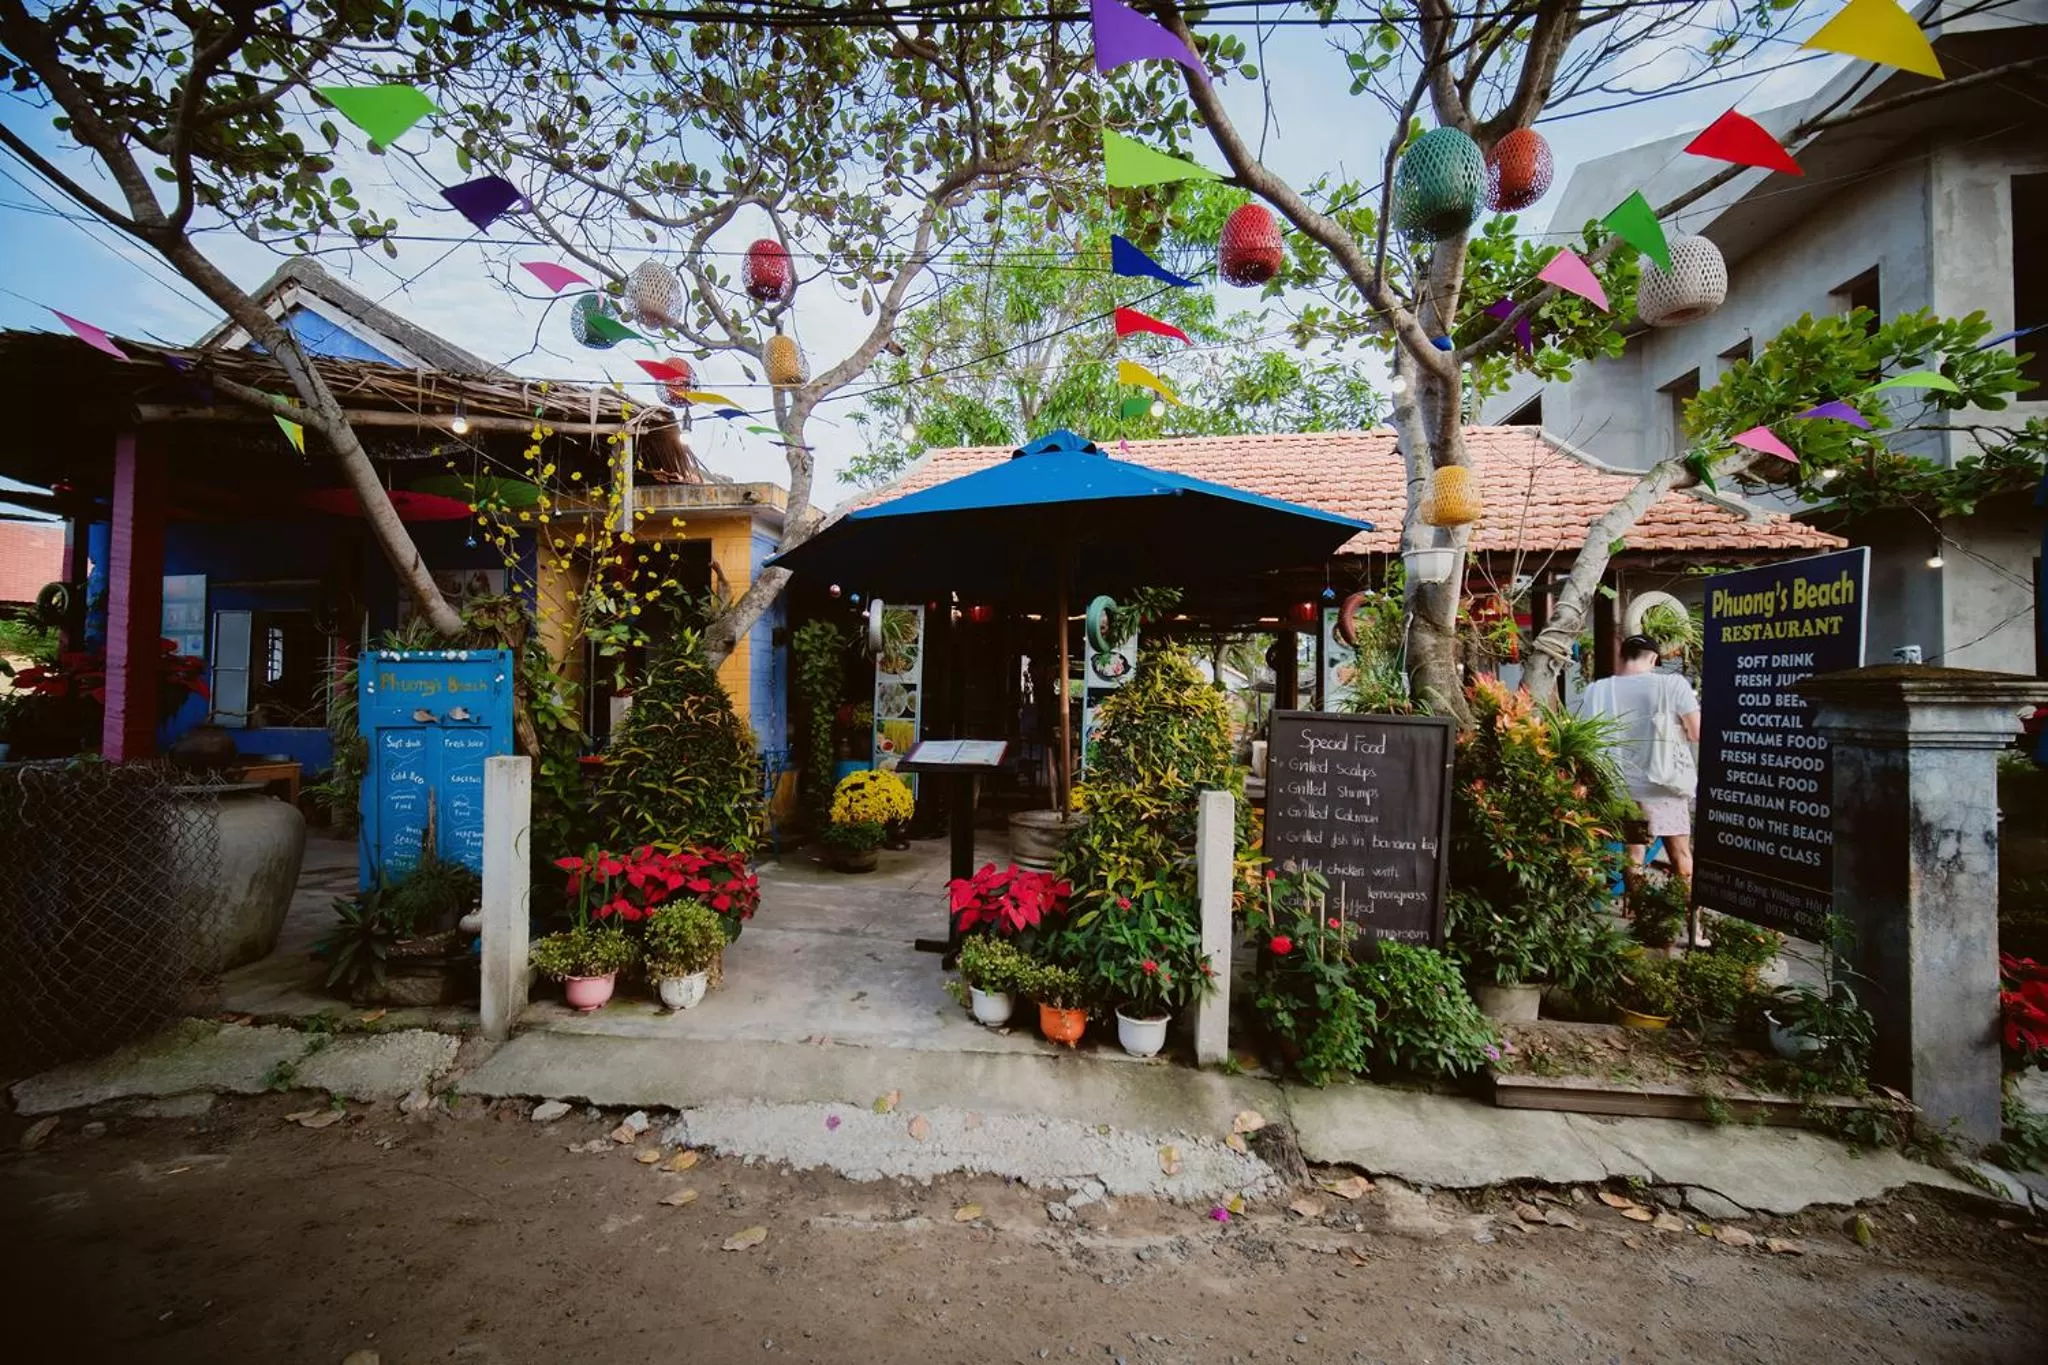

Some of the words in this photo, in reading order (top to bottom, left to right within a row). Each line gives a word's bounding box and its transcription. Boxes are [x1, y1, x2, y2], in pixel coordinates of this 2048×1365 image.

[1712, 580, 1788, 618] Phuong's
[1792, 570, 1855, 610] Beach
[1721, 616, 1843, 643] RESTAURANT
[1737, 655, 1768, 669] SOFT
[1772, 653, 1814, 667] DRINK
[1735, 674, 1772, 687] FRESH
[1775, 673, 1814, 687] JUI
[1738, 694, 1771, 707] COLD
[1740, 713, 1803, 728] COCKTAIL
[1354, 733, 1387, 754] Food
[1721, 730, 1783, 747] VIETNAME
[1787, 735, 1828, 750] FOOD
[1289, 757, 1328, 774] Grilled
[1720, 749, 1756, 765] FRESH
[1760, 753, 1824, 772] SEAFOOD
[1288, 780, 1327, 797] Grilled
[1726, 769, 1774, 788] SPECIAL
[1778, 776, 1818, 793] FOOD
[1288, 803, 1328, 820] Grilled
[1709, 787, 1784, 811] VEGETARIAN
[1789, 800, 1830, 818] FOOD
[1708, 809, 1745, 828] DINNER
[1748, 816, 1764, 830] ON
[1767, 820, 1790, 836] THE
[1792, 825, 1833, 845] BEACH
[1286, 829, 1323, 844] Grilled
[1352, 834, 1365, 846] in
[1372, 834, 1416, 850] banana
[1717, 832, 1775, 855] COOKING
[1780, 845, 1821, 867] CLASS
[1327, 863, 1365, 877] chicken
